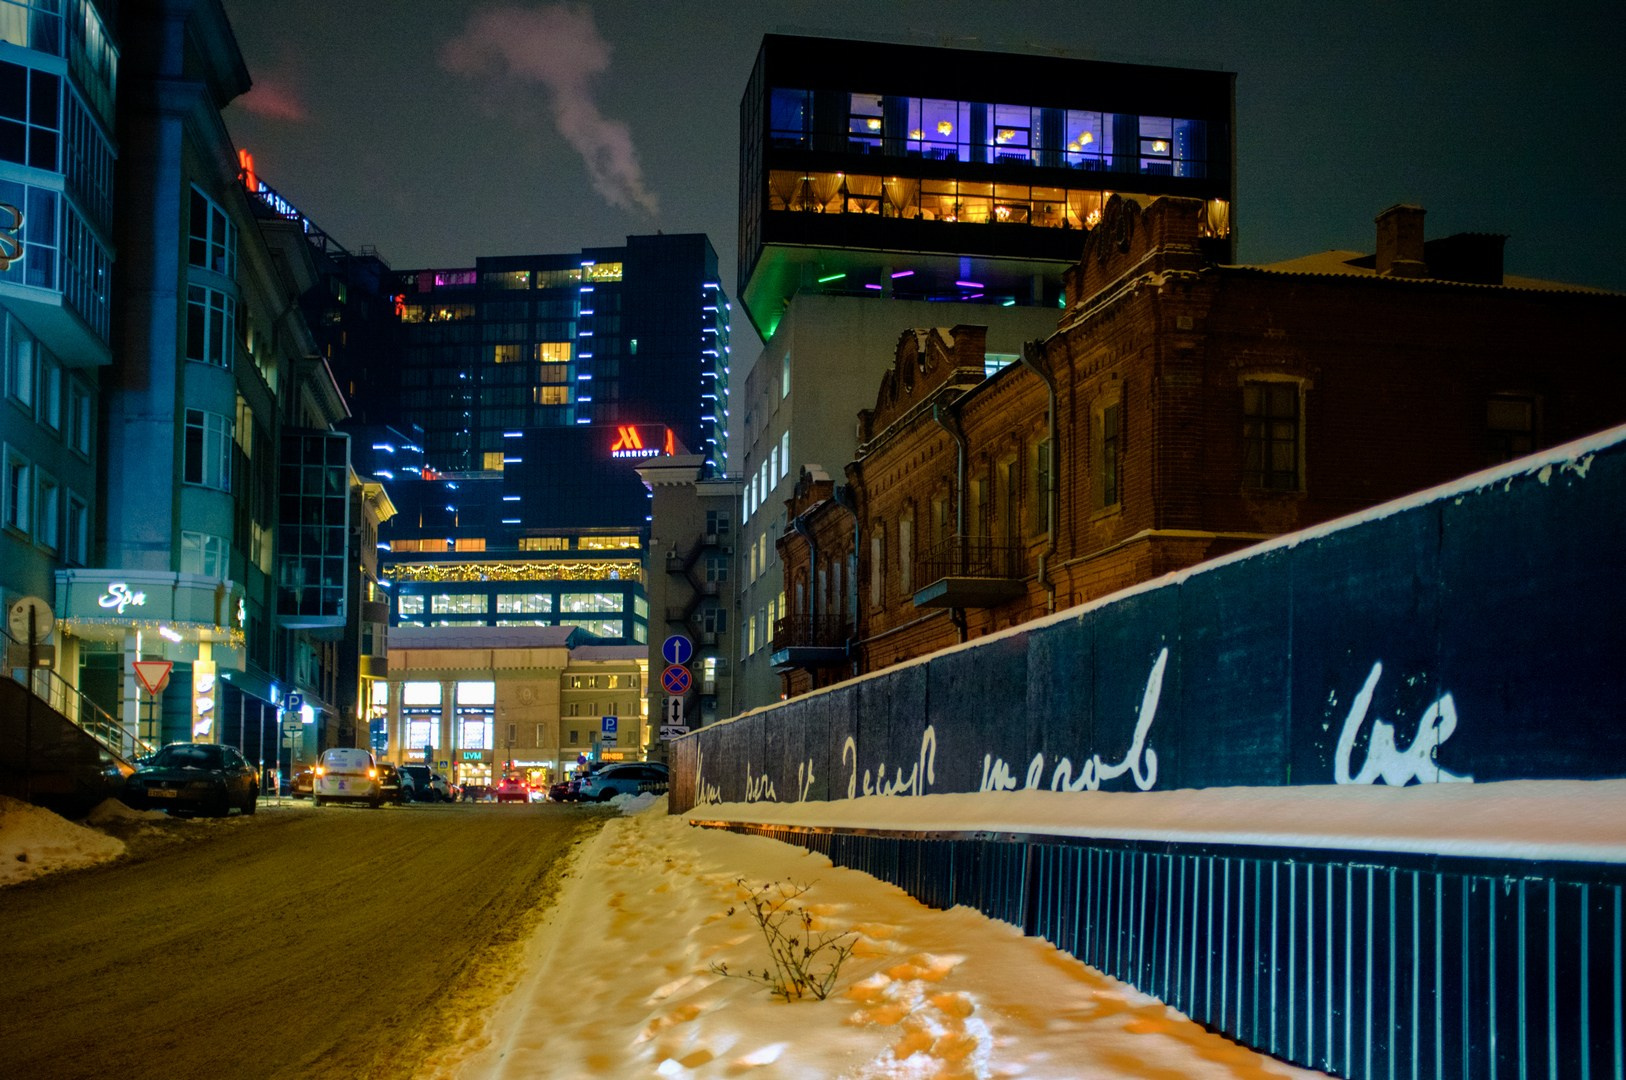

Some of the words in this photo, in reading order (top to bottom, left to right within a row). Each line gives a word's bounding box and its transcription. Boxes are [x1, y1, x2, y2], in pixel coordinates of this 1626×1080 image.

[612, 449, 660, 458] MARRIOTT
[98, 583, 147, 614] Spa
[289, 695, 300, 710] P
[605, 718, 615, 730] P
